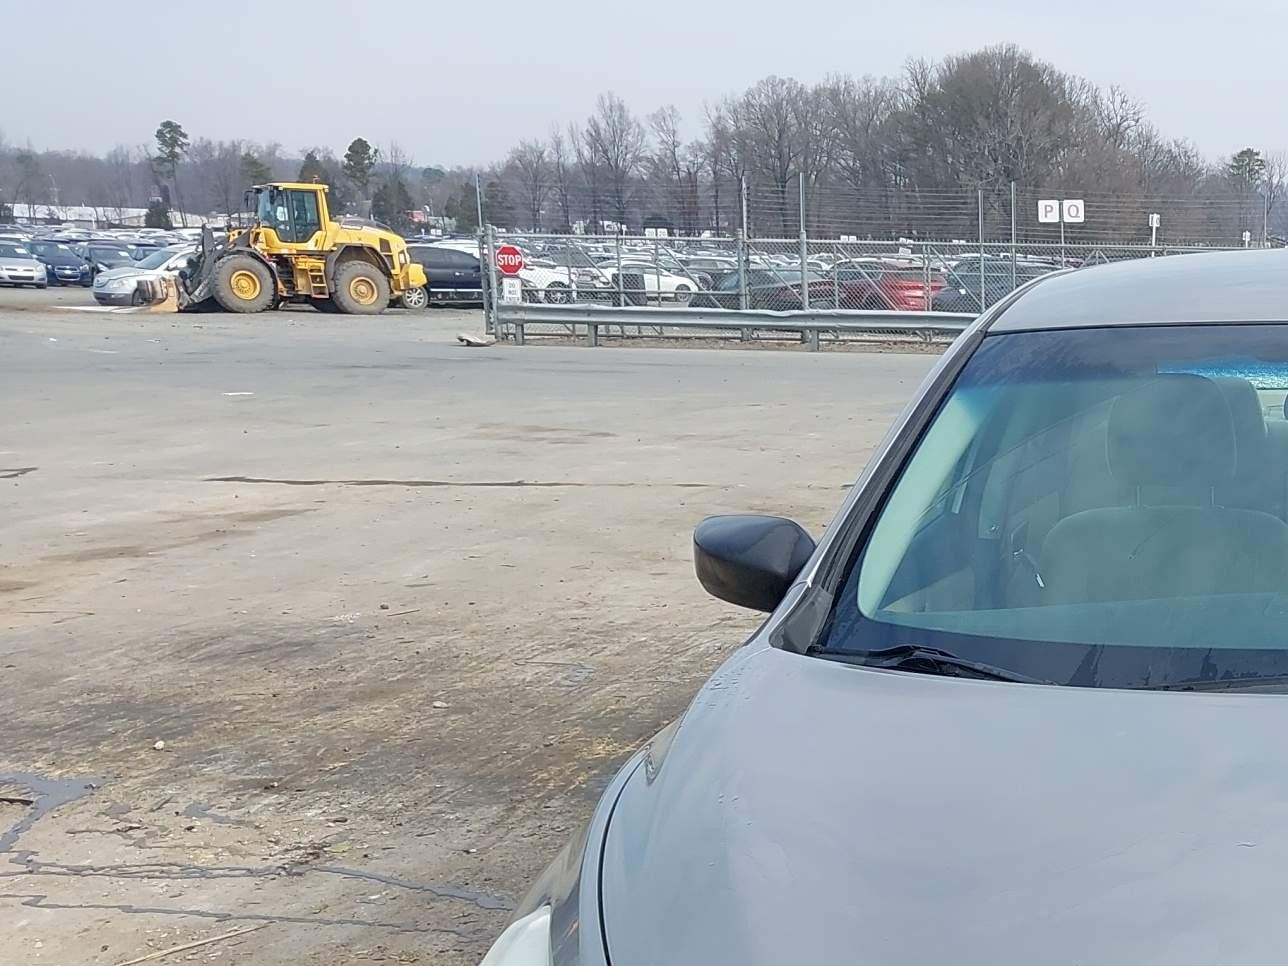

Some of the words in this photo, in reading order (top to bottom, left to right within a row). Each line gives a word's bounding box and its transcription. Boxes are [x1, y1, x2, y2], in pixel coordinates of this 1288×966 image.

[1043, 204, 1054, 218] P
[1067, 204, 1081, 219] Q
[497, 254, 522, 266] STOP
